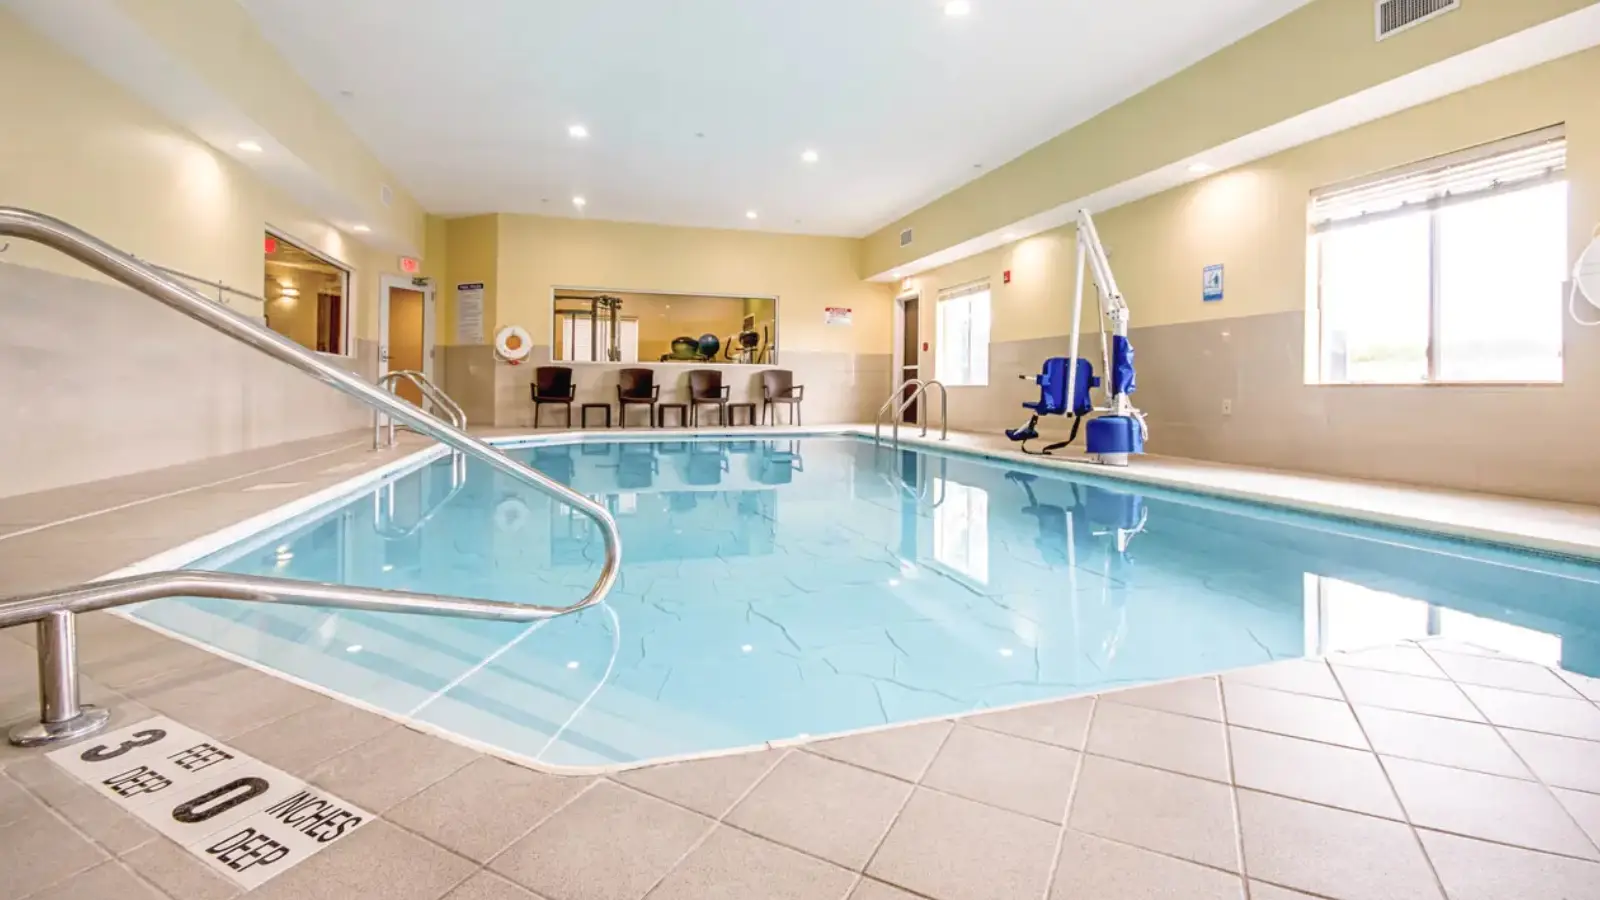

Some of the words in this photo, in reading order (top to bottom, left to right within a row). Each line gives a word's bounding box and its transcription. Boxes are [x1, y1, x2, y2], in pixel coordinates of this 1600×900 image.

[80, 728, 167, 762] 3
[166, 743, 235, 773] FEET
[102, 765, 173, 798] DEEP
[171, 776, 270, 823] 0
[264, 790, 363, 844] INCHES
[205, 827, 290, 873] DEEP
